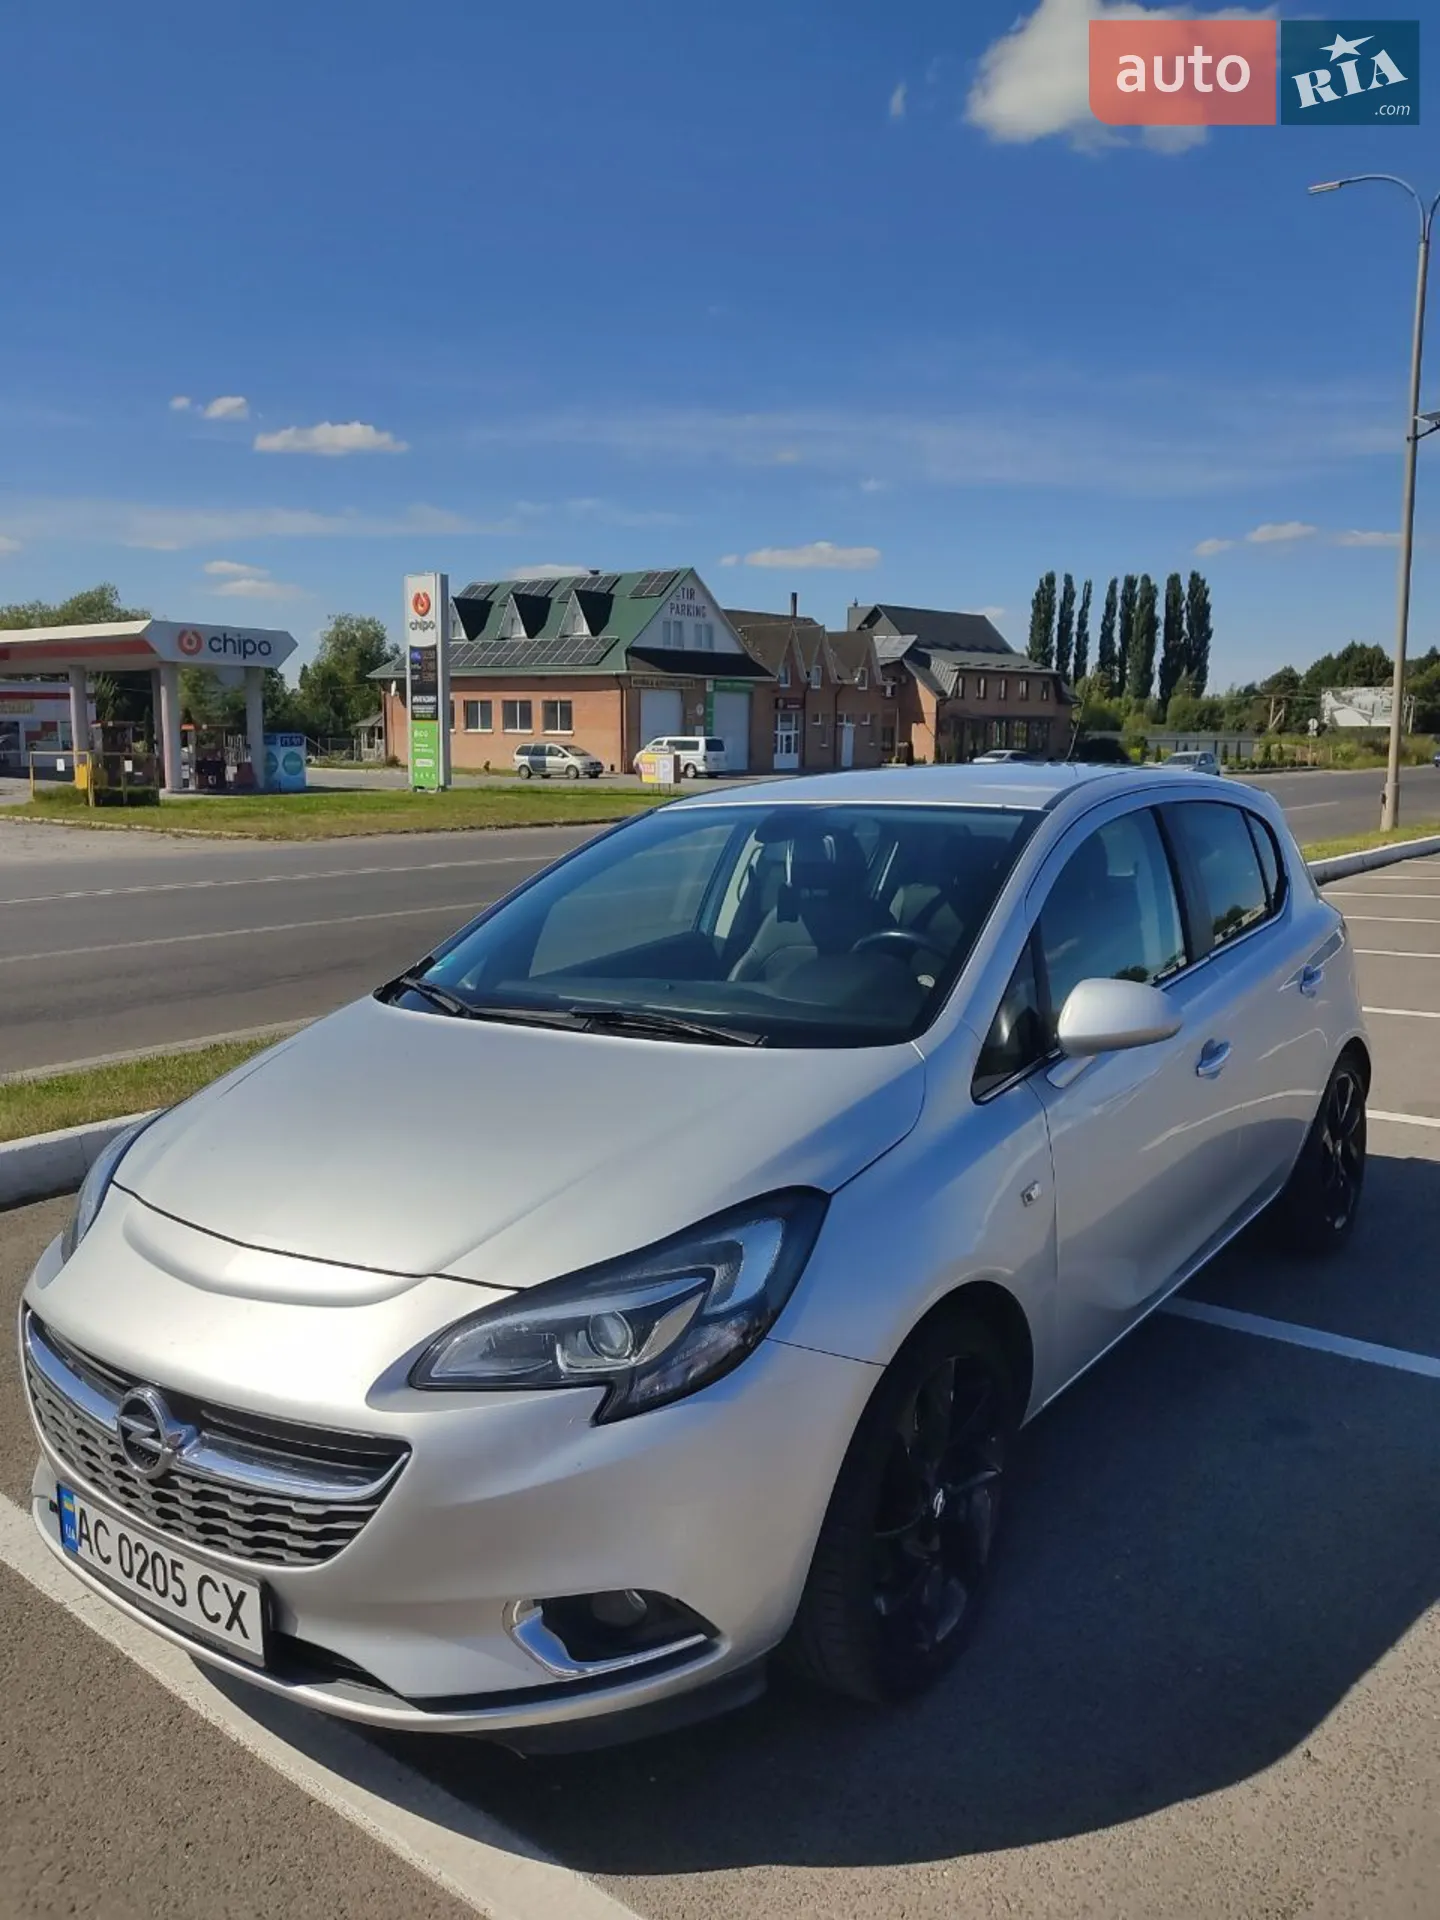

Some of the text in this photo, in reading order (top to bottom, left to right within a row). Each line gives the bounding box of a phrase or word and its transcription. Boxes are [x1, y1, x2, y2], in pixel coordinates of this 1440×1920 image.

[681, 587, 696, 600] TIR
[669, 602, 707, 619] PARKING
[409, 619, 436, 632] chipo
[208, 632, 272, 660] chipo
[77, 1507, 250, 1640] AC 0205 CX
